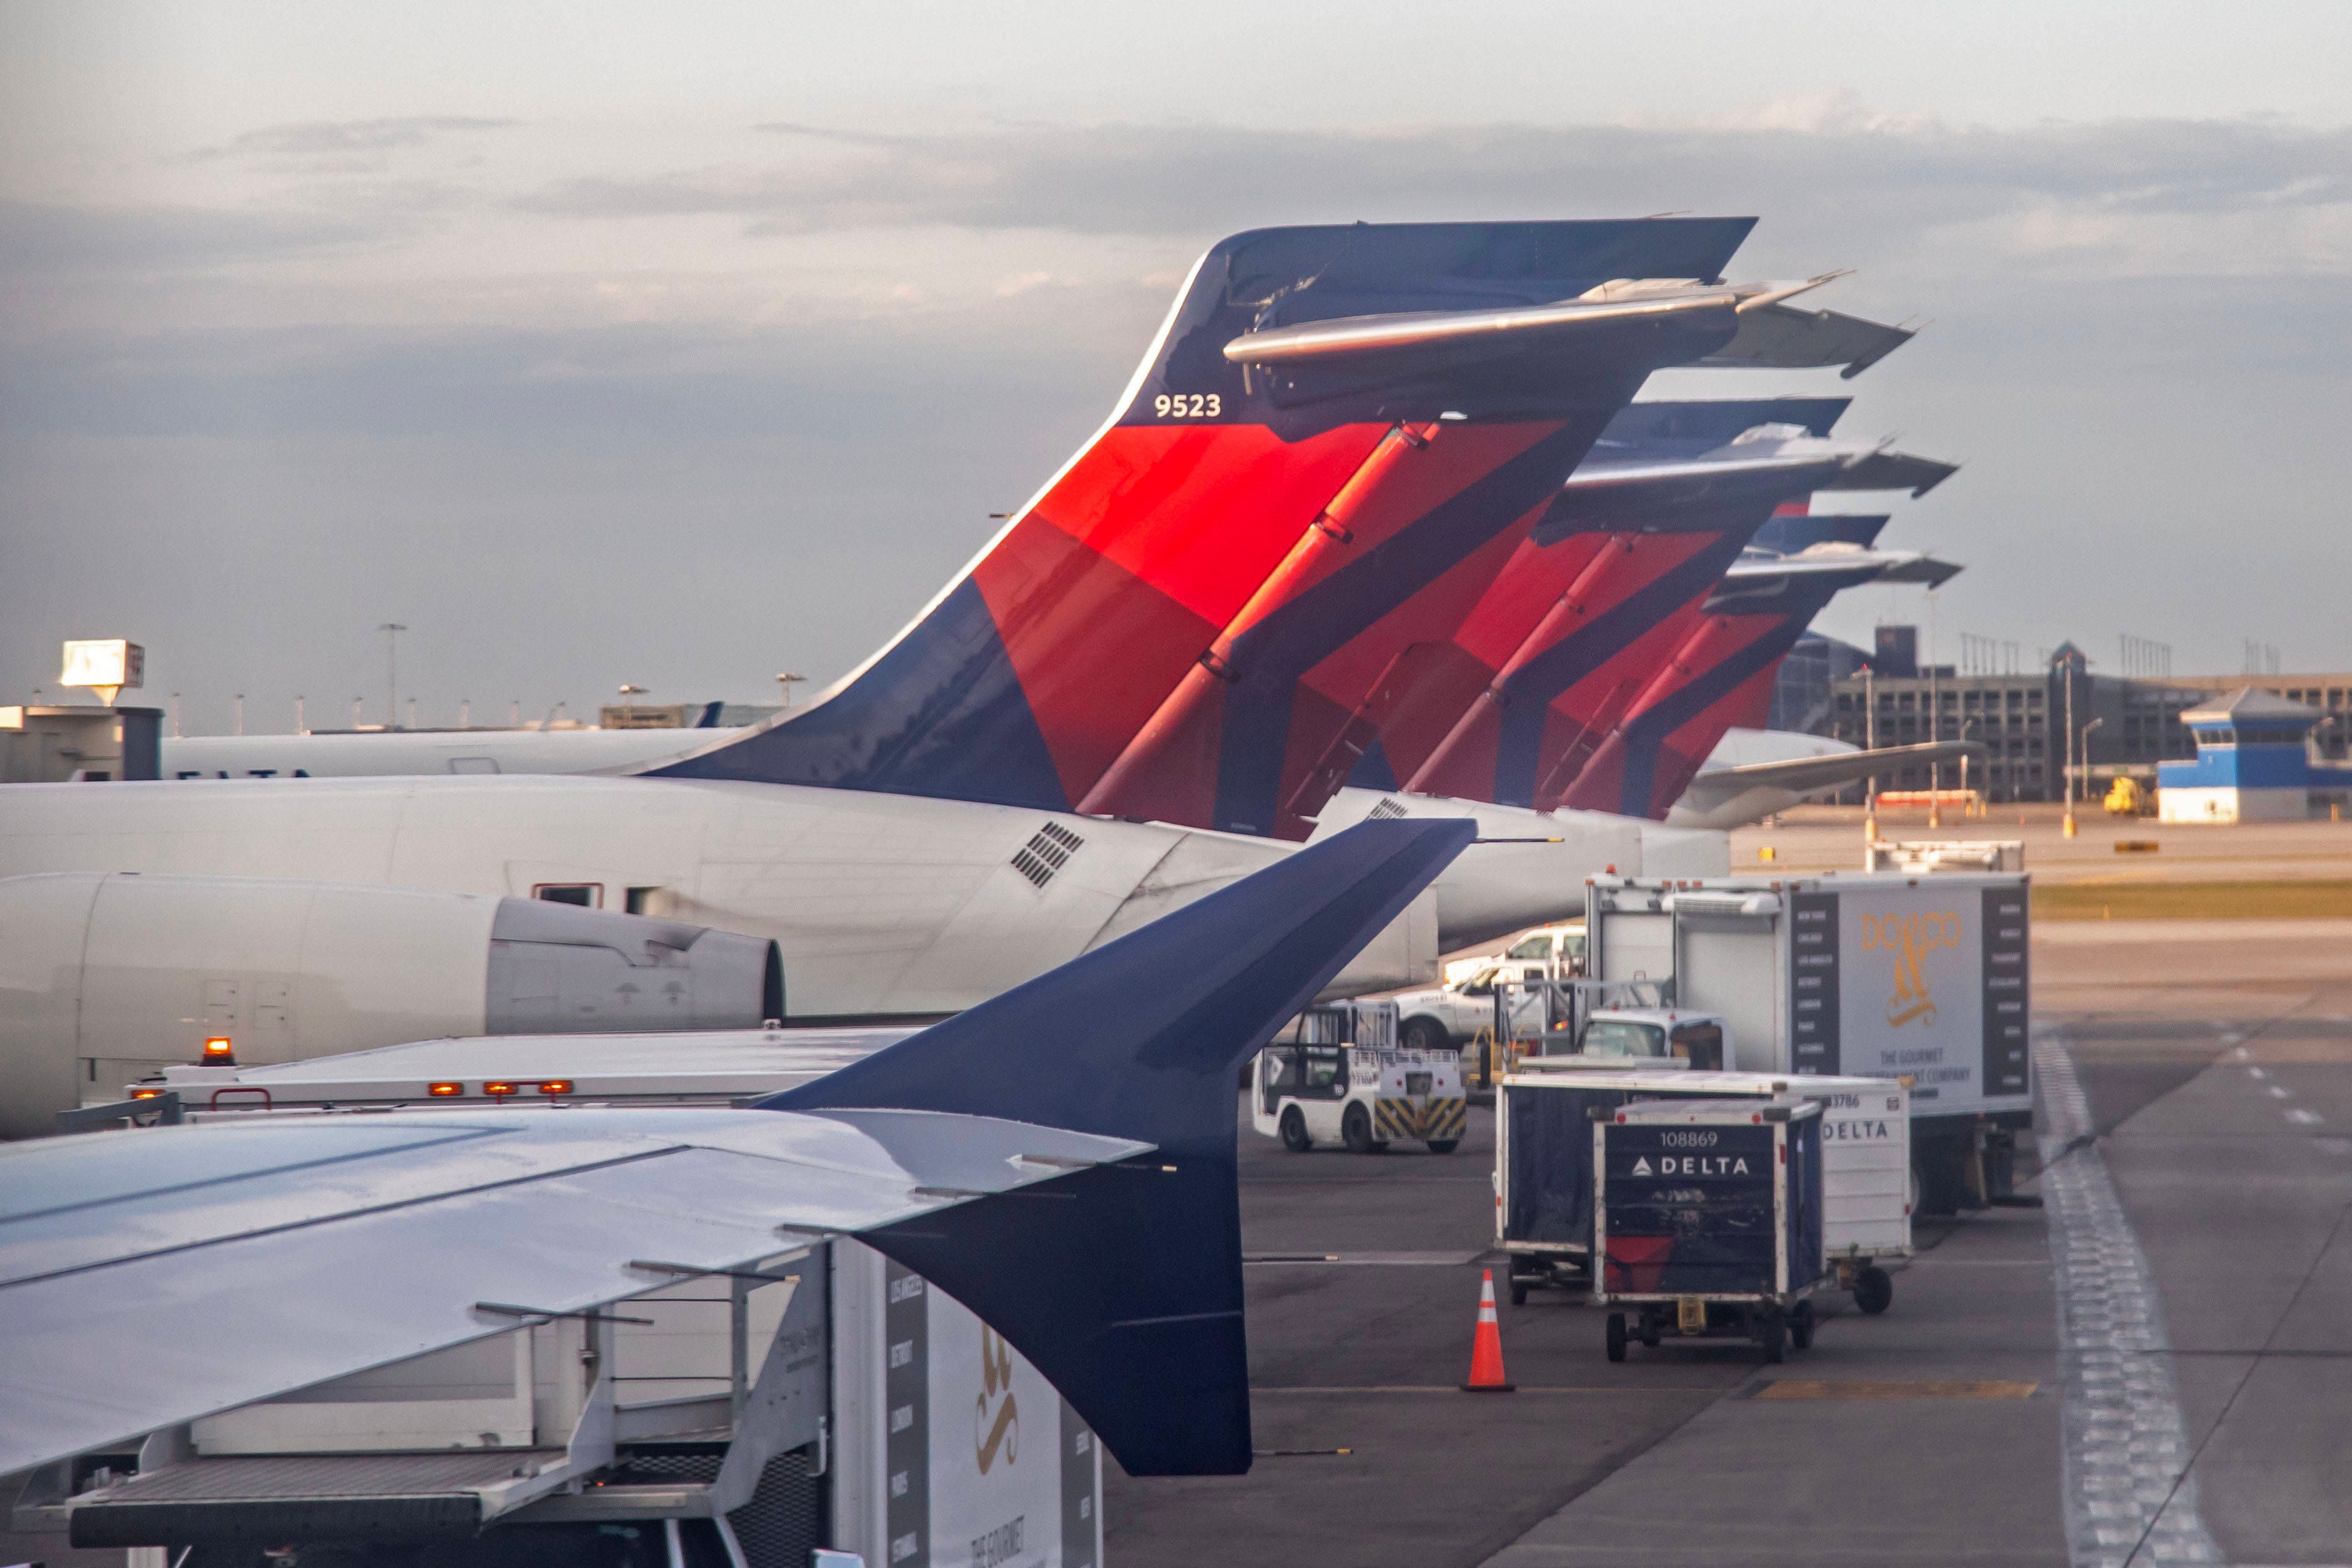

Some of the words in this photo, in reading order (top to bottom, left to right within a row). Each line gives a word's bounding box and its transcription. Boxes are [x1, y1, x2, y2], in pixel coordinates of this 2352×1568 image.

[1155, 393, 1221, 418] 9523
[1880, 1050, 1897, 1065] THE
[1899, 1047, 1944, 1064] GOURMET
[1927, 1067, 1970, 1083] COMPANY
[1822, 1120, 1887, 1140] DELTA
[1659, 1131, 1718, 1148] 108869
[1661, 1156, 1749, 1175] DELTA
